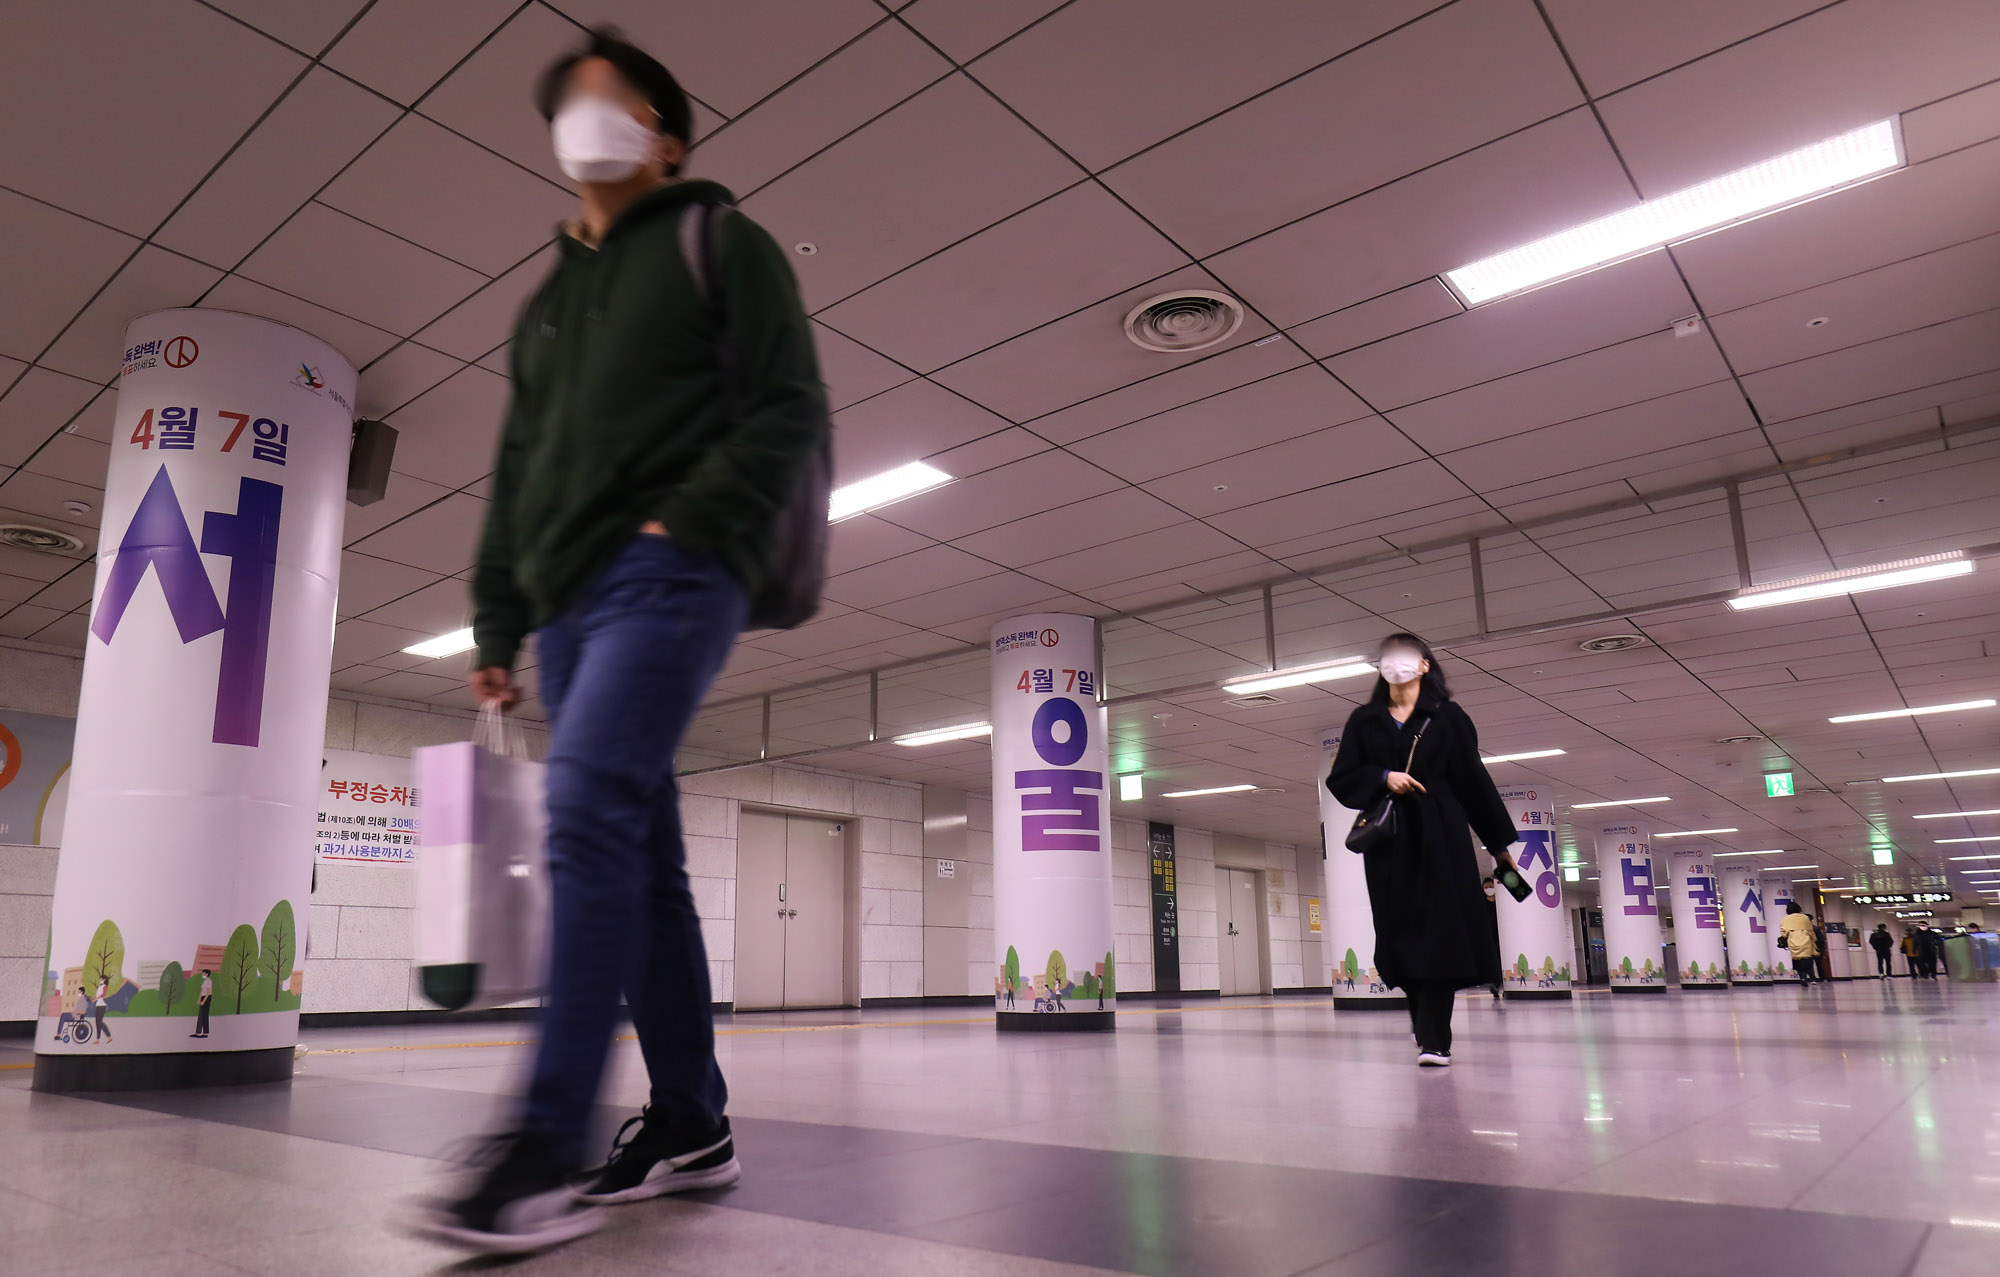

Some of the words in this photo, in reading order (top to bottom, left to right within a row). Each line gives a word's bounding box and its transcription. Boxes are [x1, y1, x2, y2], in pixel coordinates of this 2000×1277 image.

[134, 340, 163, 361] 완벽!
[130, 407, 198, 450] 4월
[218, 411, 289, 467] 7일
[91, 462, 284, 748] 서
[1018, 631, 1038, 641] 완벽!
[1016, 668, 1053, 694] 4월
[1062, 669, 1095, 696] 7일
[1015, 697, 1103, 852] 울
[368, 816, 387, 828] 의해
[1521, 811, 1542, 825] 4월
[362, 831, 381, 843] 따라
[383, 833, 401, 845] 처벌
[1618, 843, 1636, 854] 4월
[323, 843, 345, 856] 과거
[348, 844, 402, 859] 사용분까지
[1620, 858, 1658, 916] 보
[1686, 877, 1722, 929] 궐
